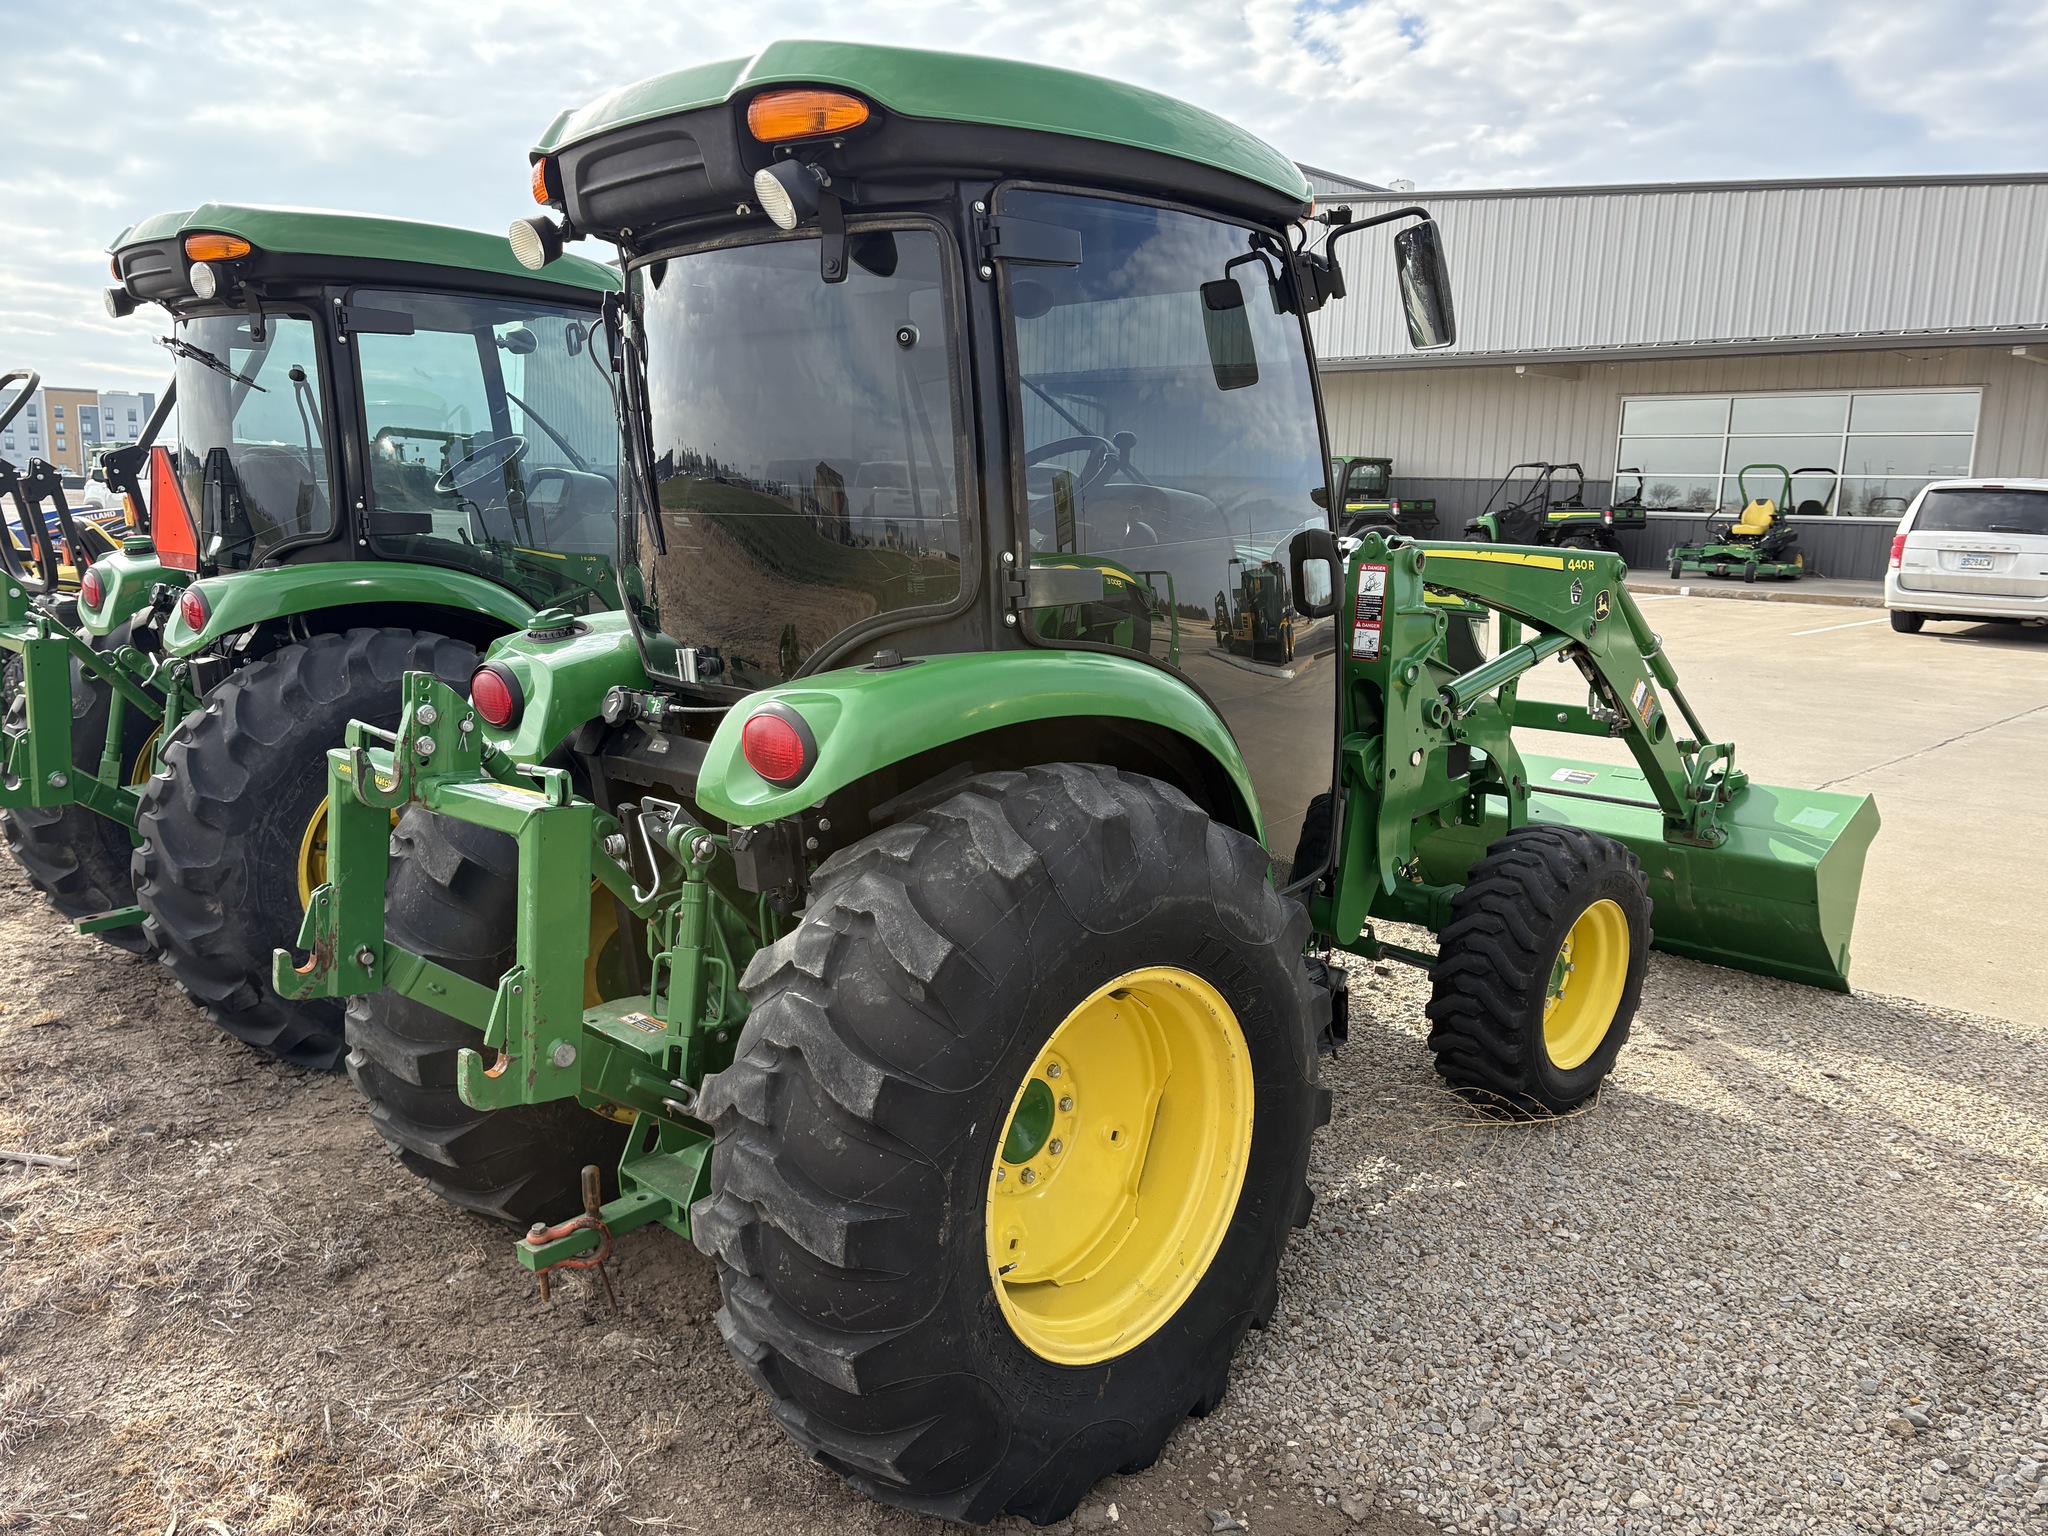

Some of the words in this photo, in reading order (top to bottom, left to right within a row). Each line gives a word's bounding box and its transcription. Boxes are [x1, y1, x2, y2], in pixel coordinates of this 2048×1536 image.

[84, 510, 116, 521] OLLAND
[374, 774, 391, 787] Match
[1186, 931, 1282, 1042] TITAN
